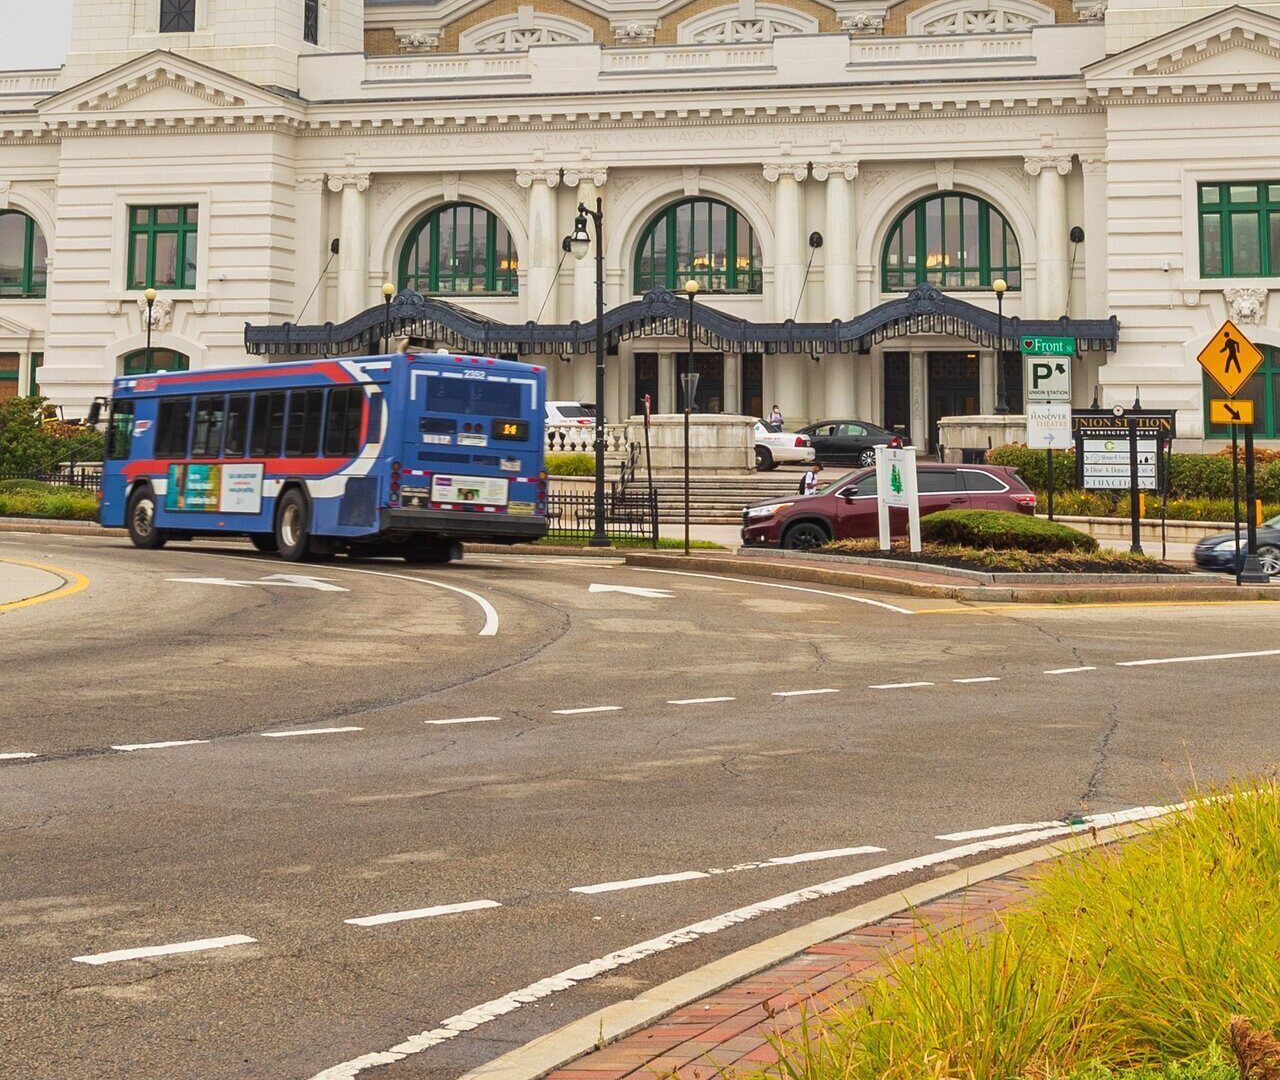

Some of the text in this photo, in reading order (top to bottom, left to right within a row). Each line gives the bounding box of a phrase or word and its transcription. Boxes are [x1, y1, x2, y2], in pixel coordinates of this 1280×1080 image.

[361, 120, 1035, 152] BOSTON AND ALBANY NEW YORK NEW HAVEN AND HARTFORD BOSTON AND MAINE
[1035, 338, 1063, 352] Front
[463, 369, 486, 380] 2352
[1032, 363, 1053, 390] P
[1030, 413, 1068, 421] HANOVER
[503, 424, 518, 435] 14
[1115, 418, 1172, 431] STTION
